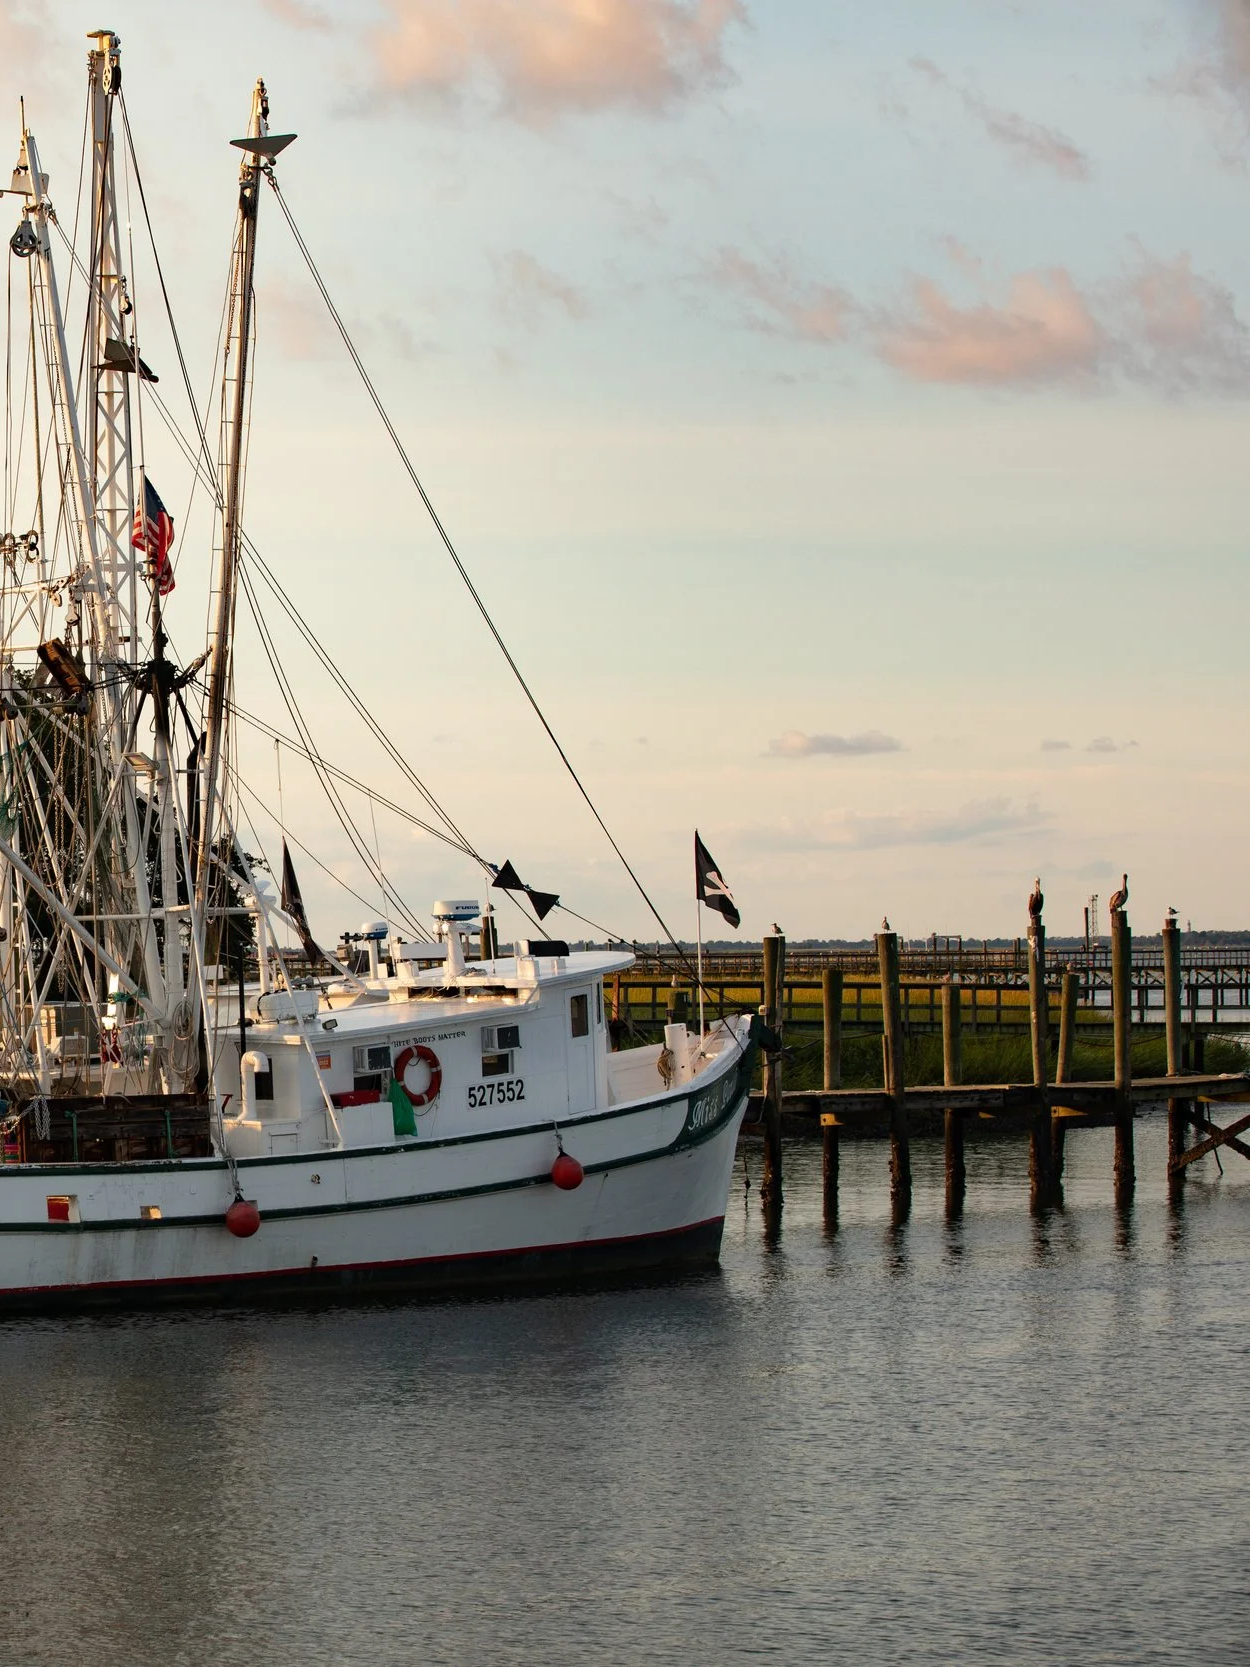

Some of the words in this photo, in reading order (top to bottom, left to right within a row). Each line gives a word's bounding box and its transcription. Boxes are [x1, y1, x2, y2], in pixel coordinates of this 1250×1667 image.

[413, 1034, 436, 1045] BOOTS
[438, 1030, 466, 1041] MATTER
[468, 1079, 525, 1108] 527552
